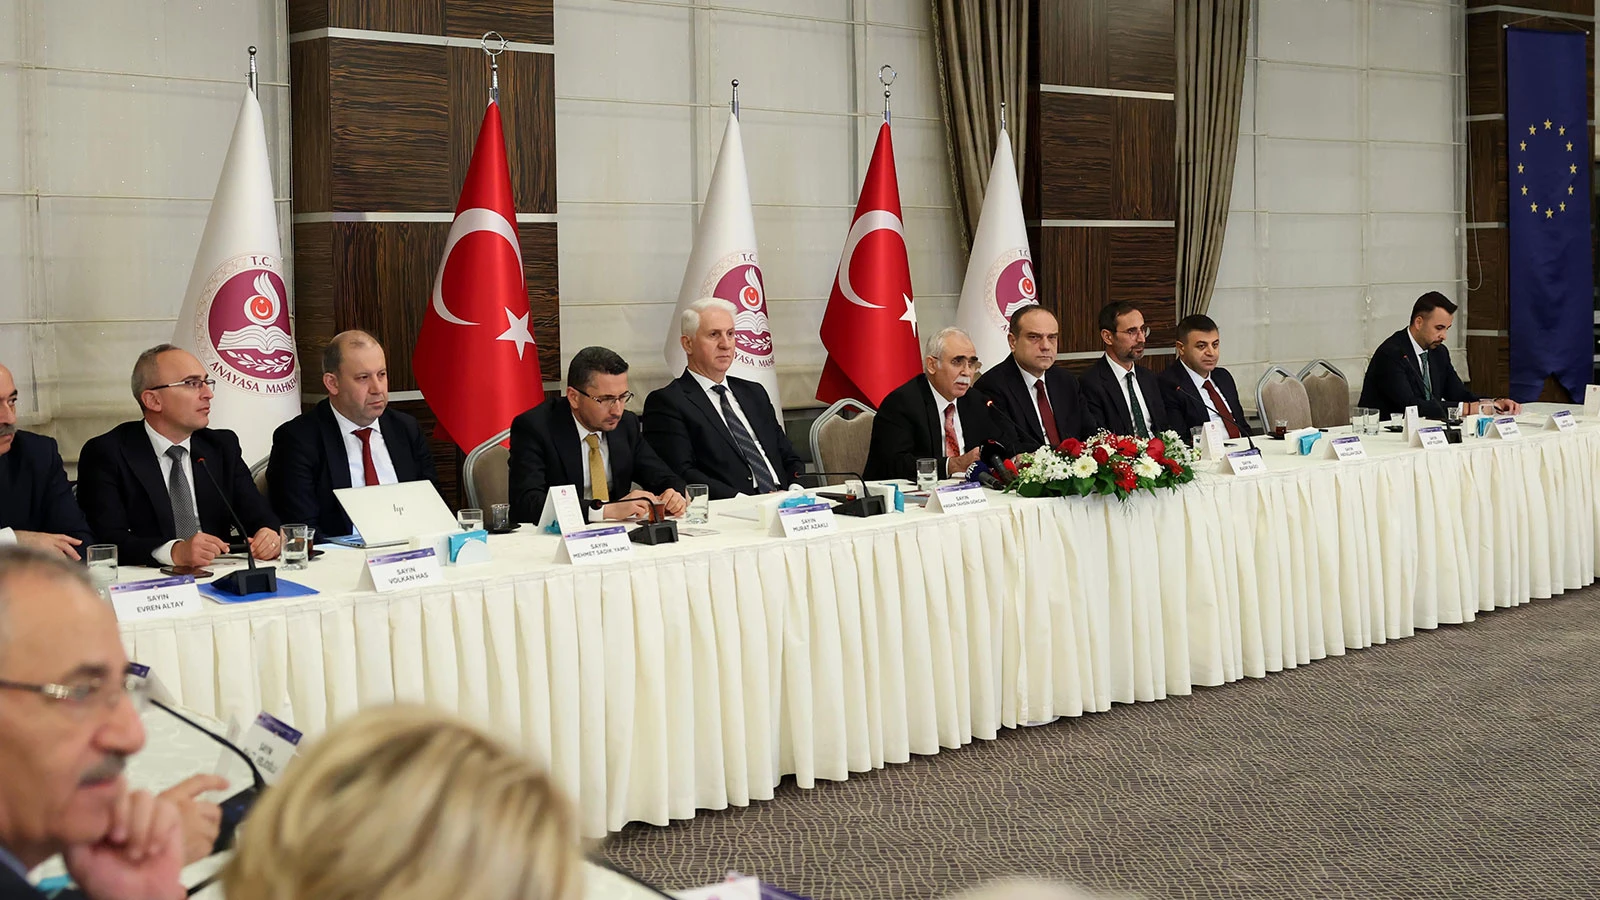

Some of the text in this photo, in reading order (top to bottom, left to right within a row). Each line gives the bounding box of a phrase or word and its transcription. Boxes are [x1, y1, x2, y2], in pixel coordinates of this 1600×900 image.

[250, 255, 272, 268] T.C.
[734, 354, 755, 366] YASA
[209, 361, 260, 392] ANAYASA
[393, 504, 404, 516] hp
[396, 567, 416, 575] SAYIN
[388, 576, 414, 584] VOLKAN
[146, 594, 169, 602] SAYIN
[136, 601, 184, 613] EVREN ALTAY
